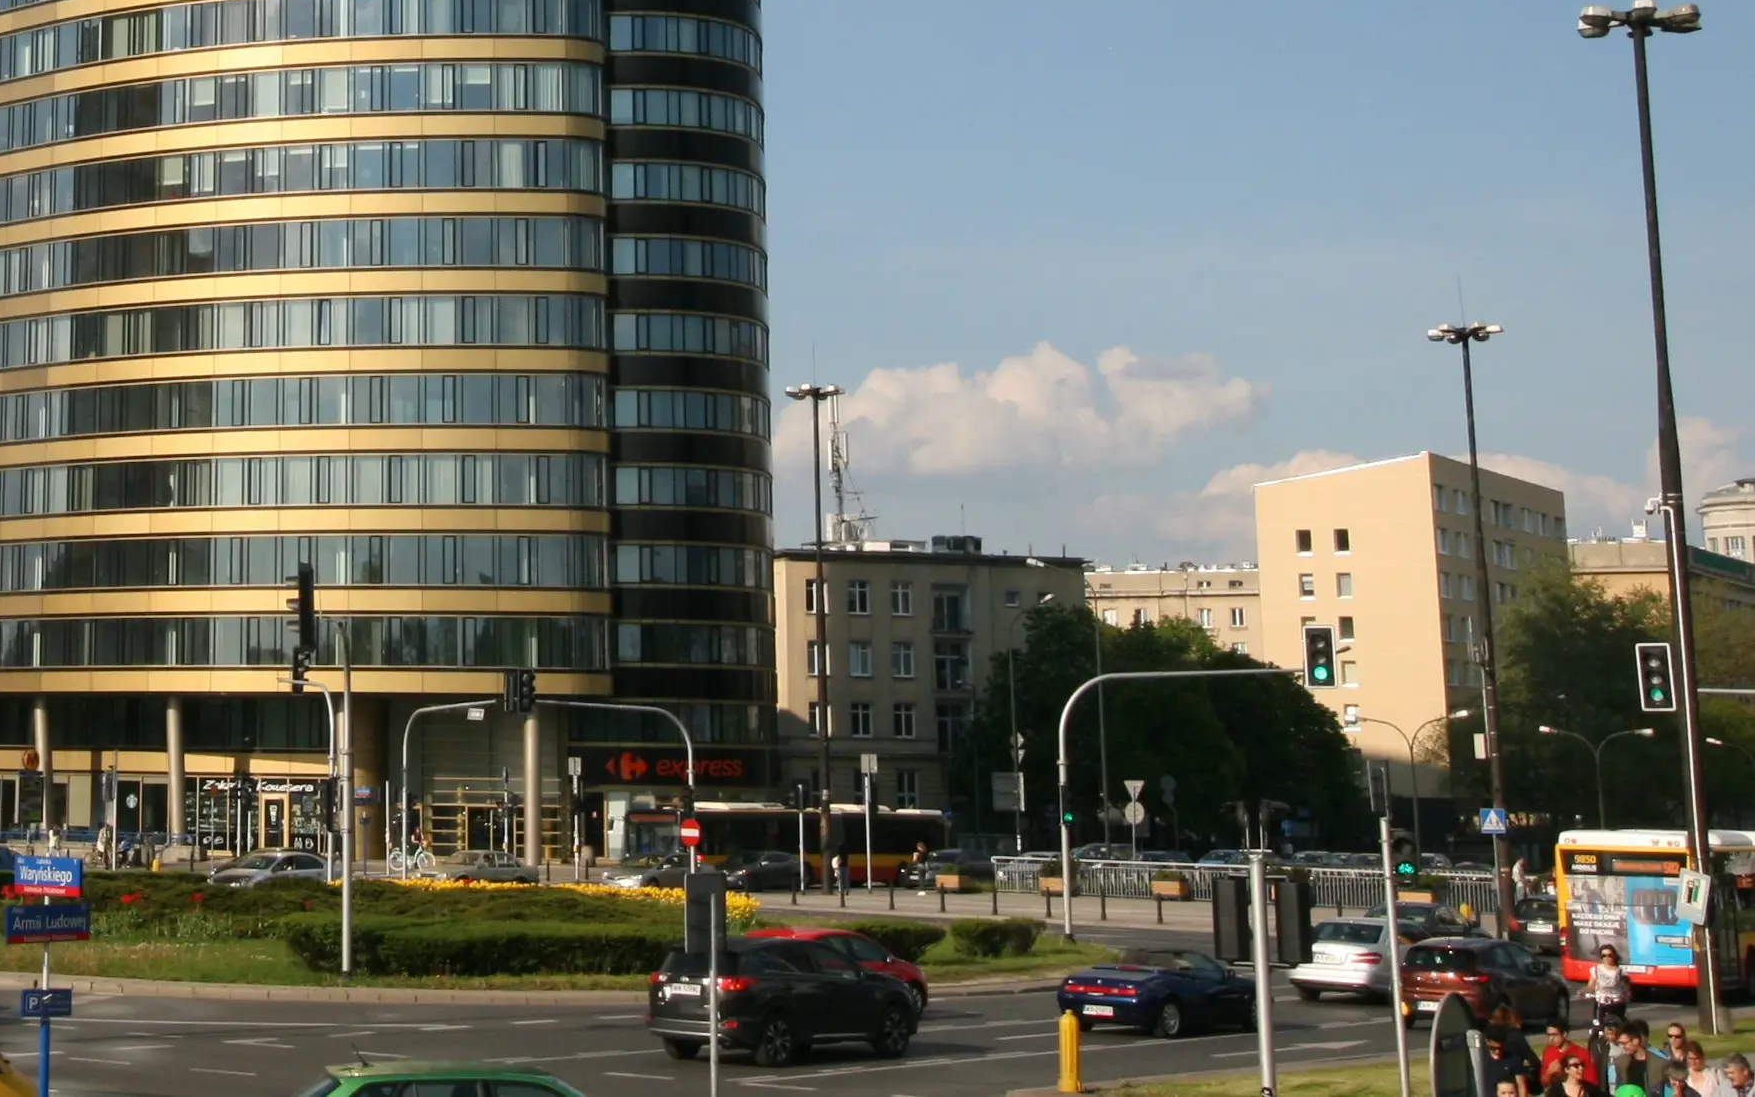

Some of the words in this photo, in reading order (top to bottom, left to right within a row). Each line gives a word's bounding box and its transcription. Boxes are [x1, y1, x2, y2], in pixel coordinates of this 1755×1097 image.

[655, 758, 744, 780] express
[19, 865, 73, 886] Waryńskiego
[13, 915, 42, 930] Armii
[46, 913, 86, 931] Ludowej
